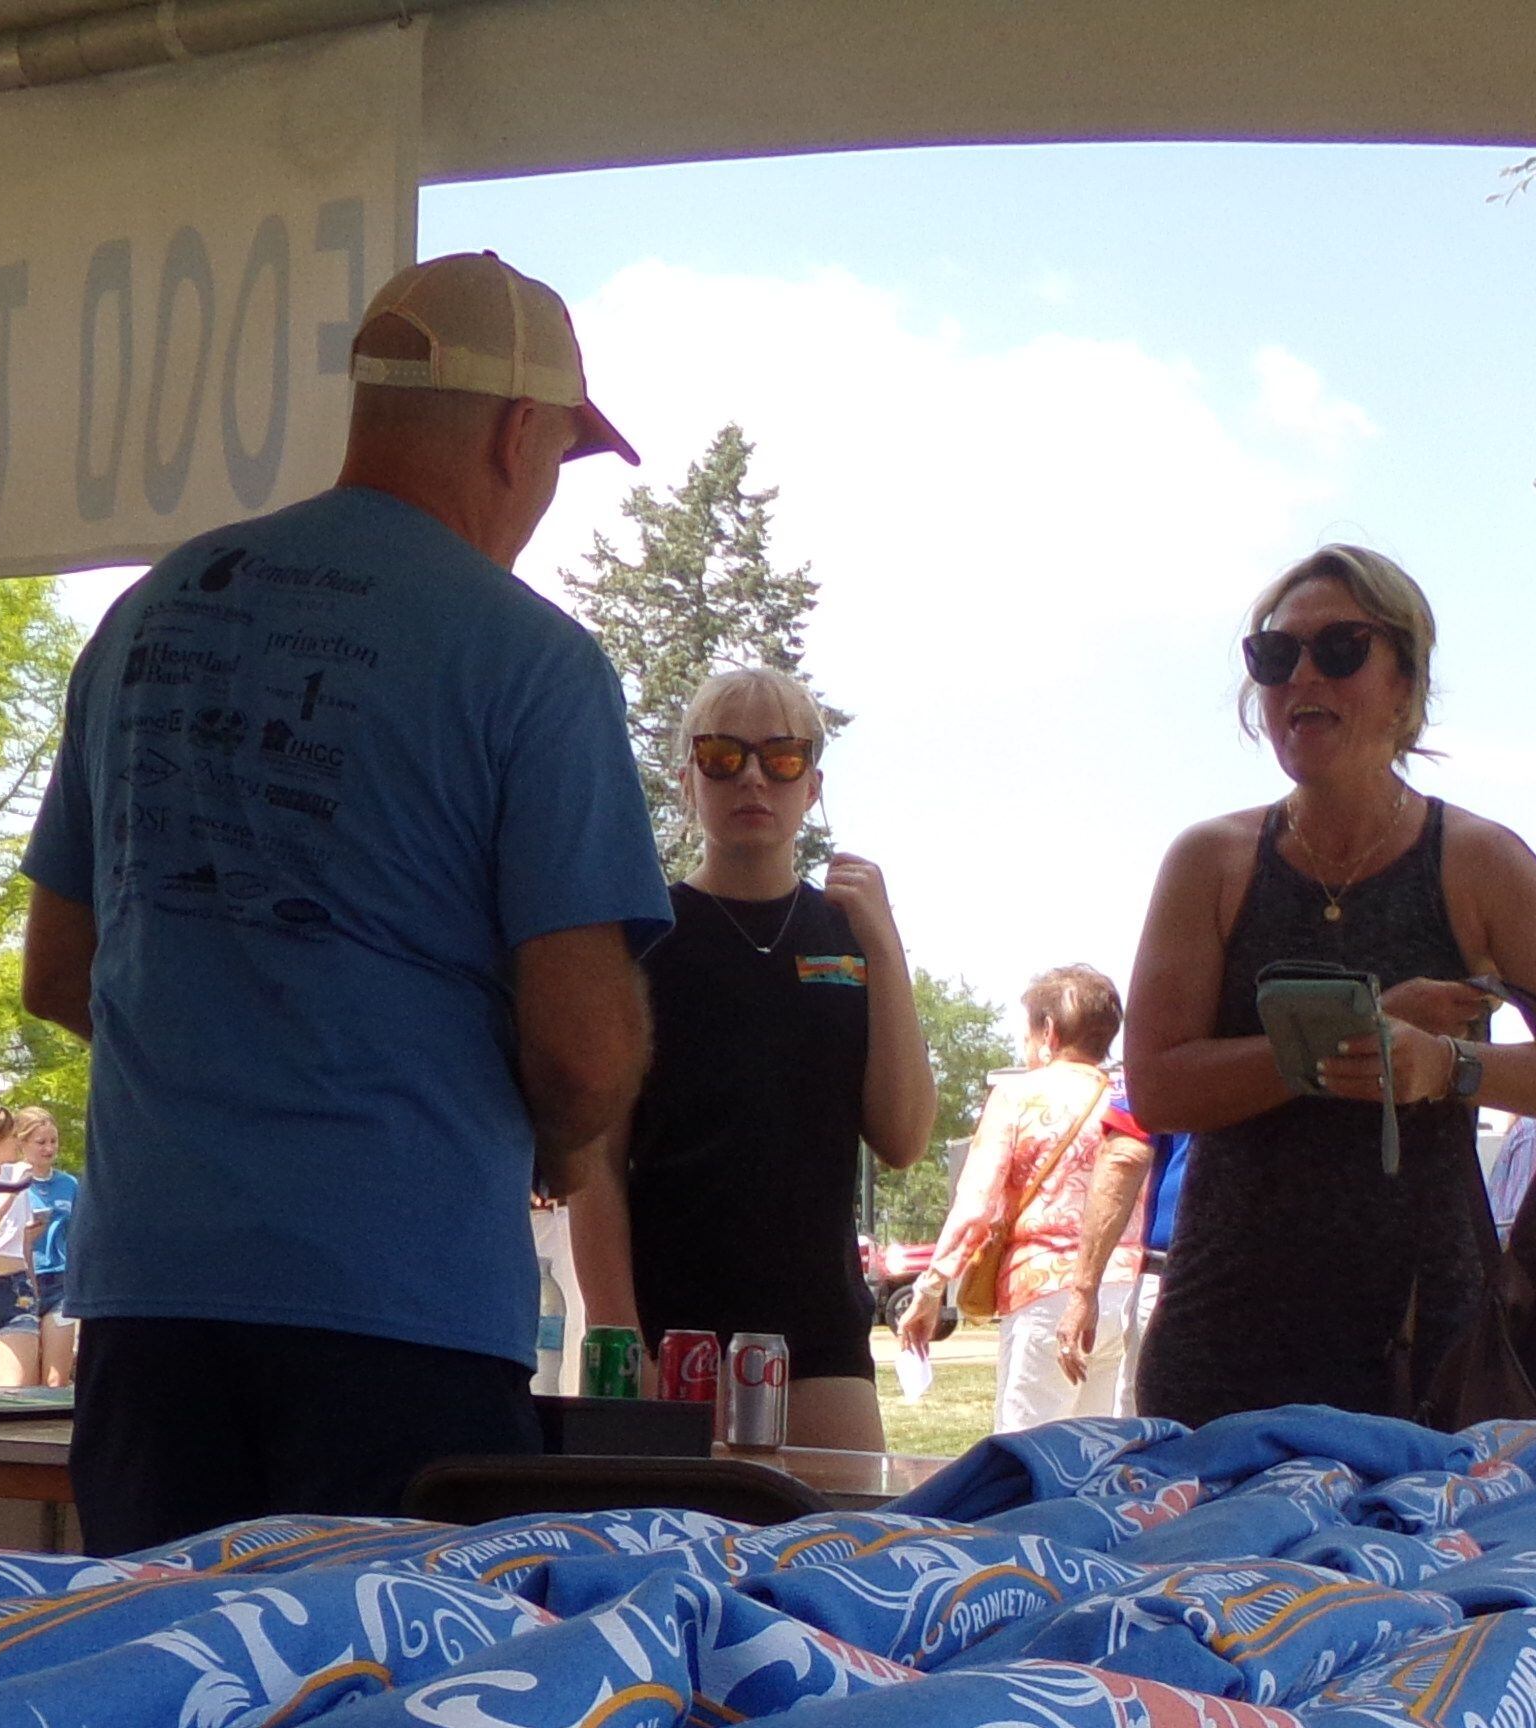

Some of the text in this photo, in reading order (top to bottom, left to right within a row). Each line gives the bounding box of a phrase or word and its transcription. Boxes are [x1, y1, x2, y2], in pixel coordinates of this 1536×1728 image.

[243, 556, 375, 598] Central Bank
[265, 630, 380, 669] princeton
[440, 1530, 571, 1579] PRINCETON
